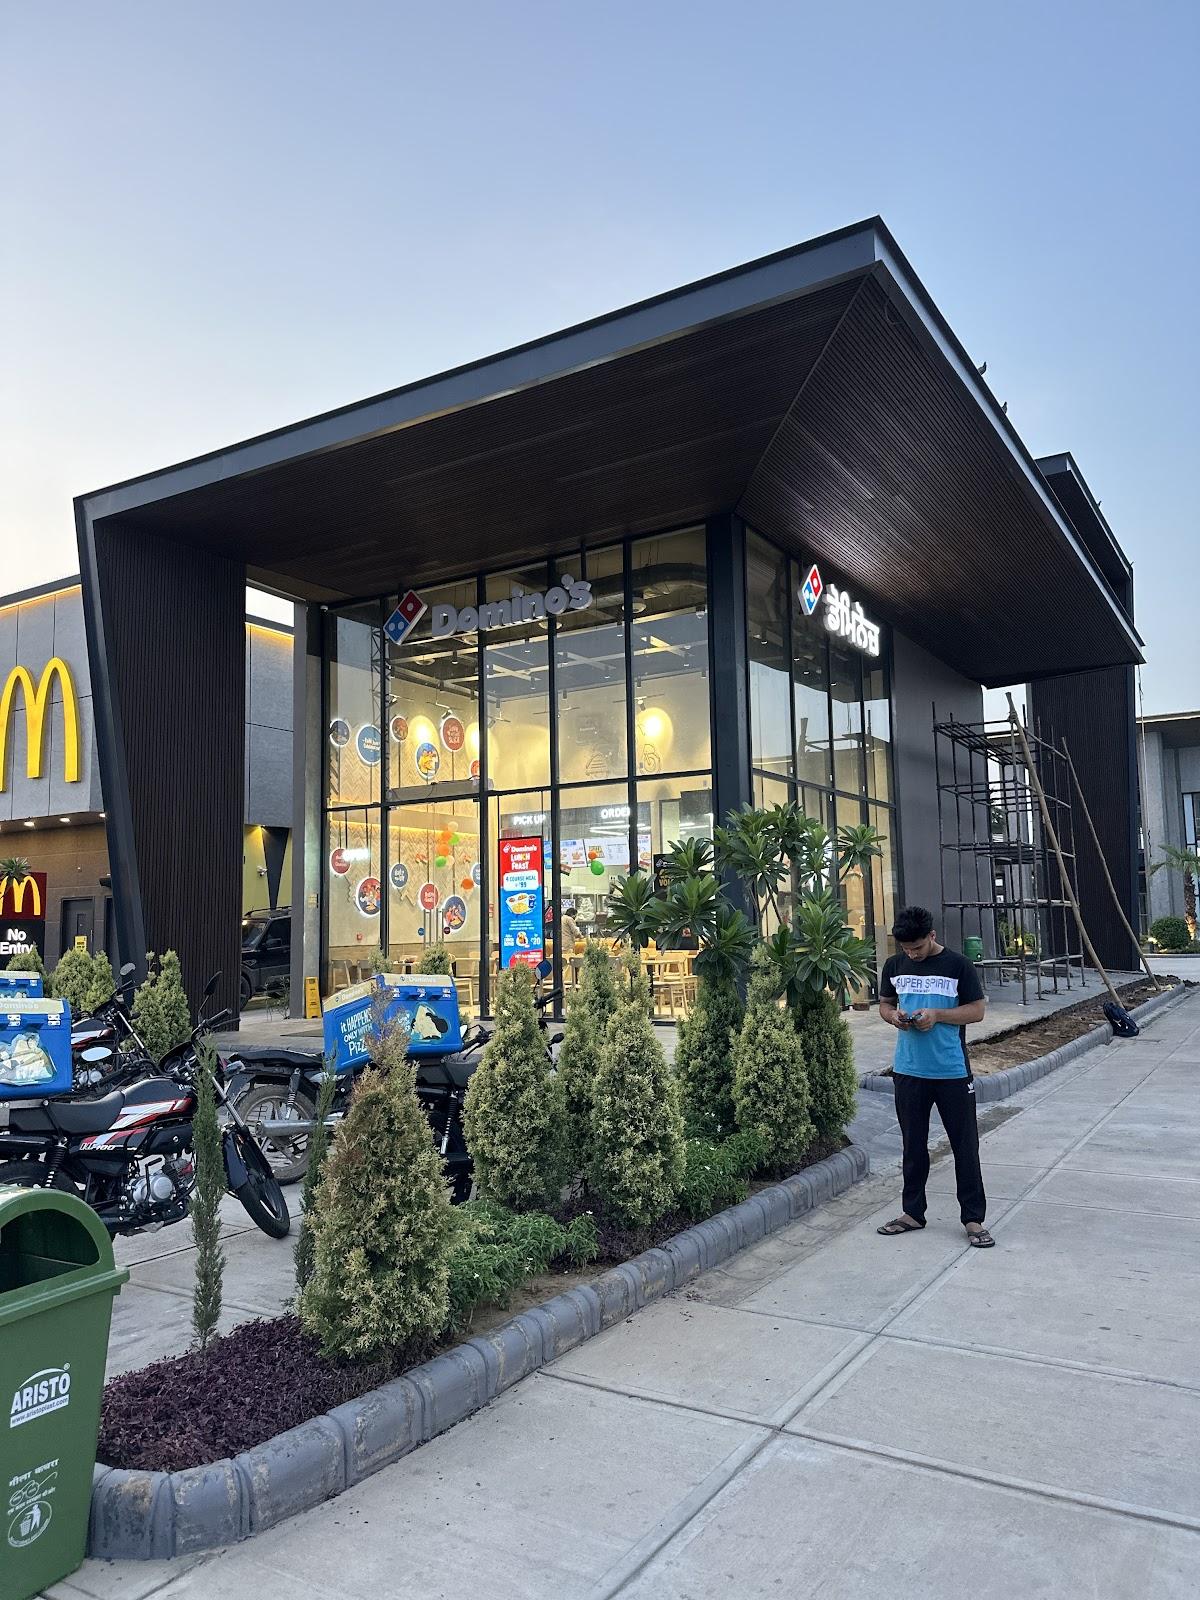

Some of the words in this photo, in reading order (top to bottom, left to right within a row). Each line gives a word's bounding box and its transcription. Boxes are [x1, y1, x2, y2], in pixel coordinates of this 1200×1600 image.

[431, 574, 593, 639] Domino's
[513, 815, 534, 826] PICK
[534, 814, 546, 825] UP
[511, 844, 538, 853] Domino's
[510, 853, 531, 862] LUNCH
[511, 861, 530, 870] FEAST
[7, 928, 27, 941] No
[0, 942, 34, 955] Entry
[896, 977, 923, 989] SUPER
[924, 978, 952, 990] SPIRIT
[344, 1029, 358, 1043] ONLY
[10, 1373, 71, 1415] ARISTO
